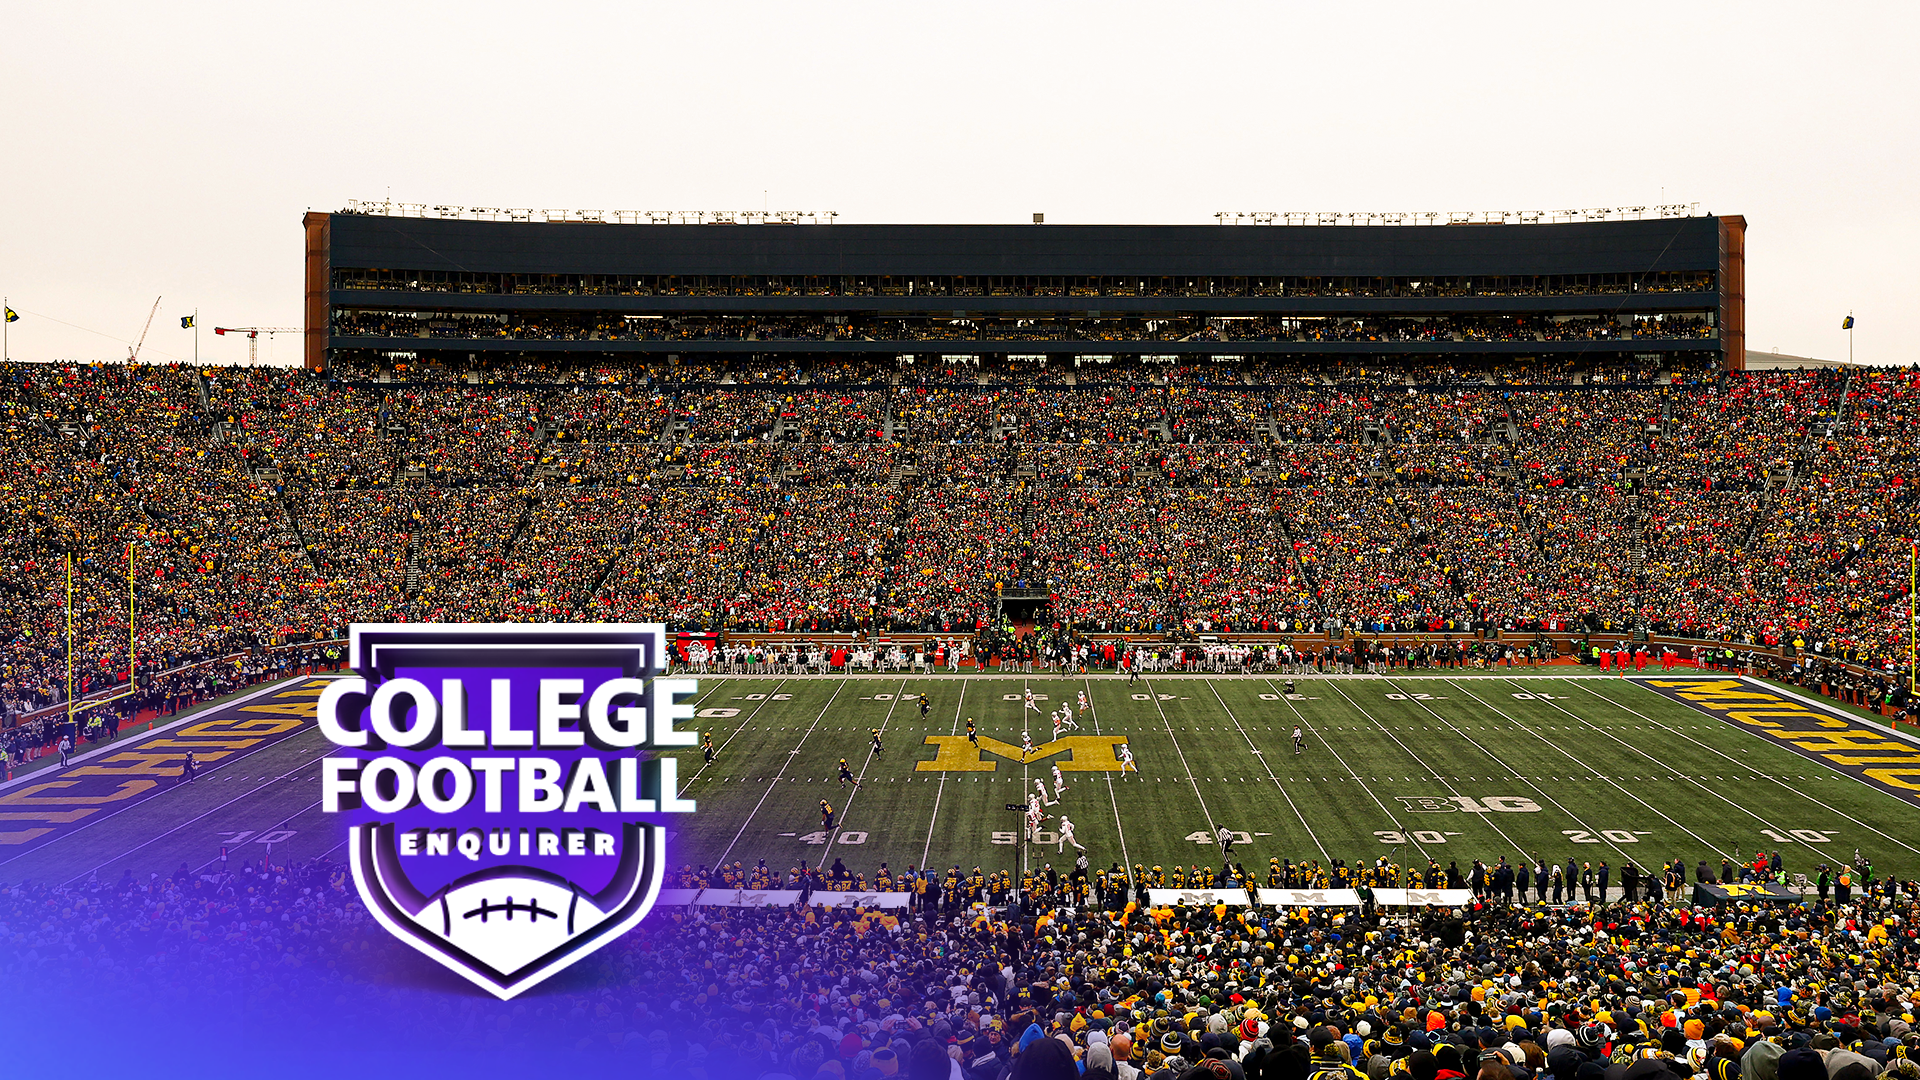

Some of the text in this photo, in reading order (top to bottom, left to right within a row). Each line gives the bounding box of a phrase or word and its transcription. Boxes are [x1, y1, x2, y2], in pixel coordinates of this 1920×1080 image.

[914, 735, 1137, 772] M
[799, 831, 869, 845] 40
[991, 831, 1060, 845] 50
[1185, 831, 1254, 845] 40
[1373, 830, 1447, 844] 30
[1561, 830, 1639, 843] 20
[1760, 829, 1832, 843] 10
[842, 895, 878, 905] M
[1181, 893, 1217, 903] M
[1291, 893, 1328, 903] M
[1410, 893, 1444, 903] M
